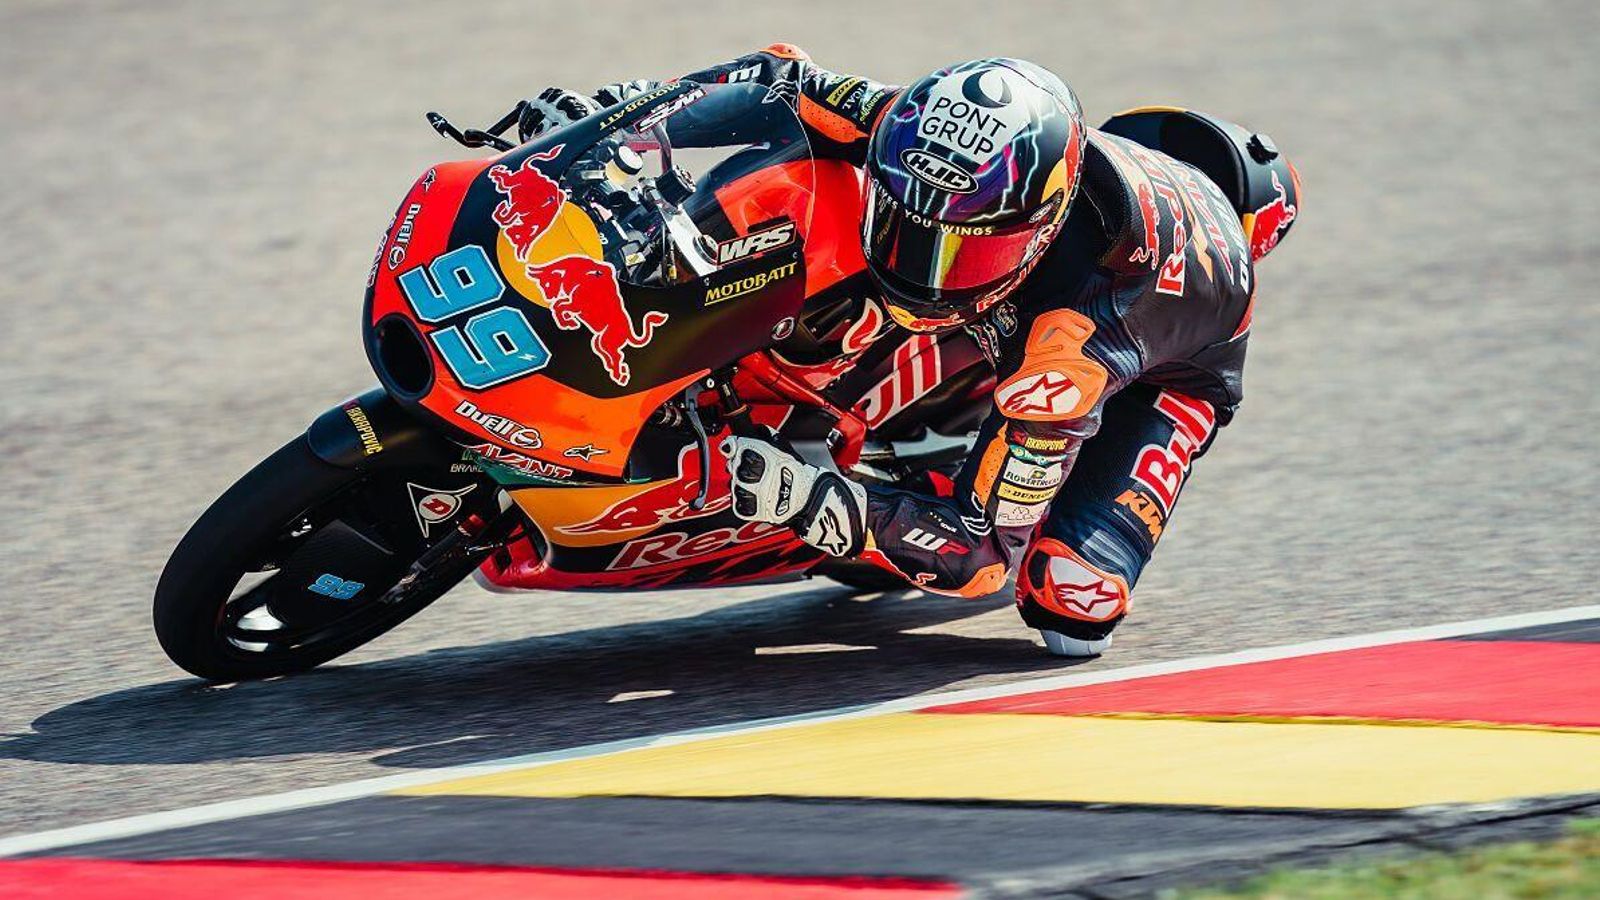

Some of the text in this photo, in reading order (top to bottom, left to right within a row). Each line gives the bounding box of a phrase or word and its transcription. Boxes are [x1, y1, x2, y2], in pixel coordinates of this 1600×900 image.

[922, 116, 994, 157] GRUP
[932, 97, 1006, 141] PONT
[907, 153, 970, 187] HJC
[904, 208, 932, 228] YOU
[940, 223, 993, 236] WINGS
[720, 226, 794, 263] WRS
[704, 262, 797, 302] MOTOBATT
[398, 243, 553, 391] 99
[1130, 387, 1215, 518] Bull
[1114, 489, 1165, 546] KTM
